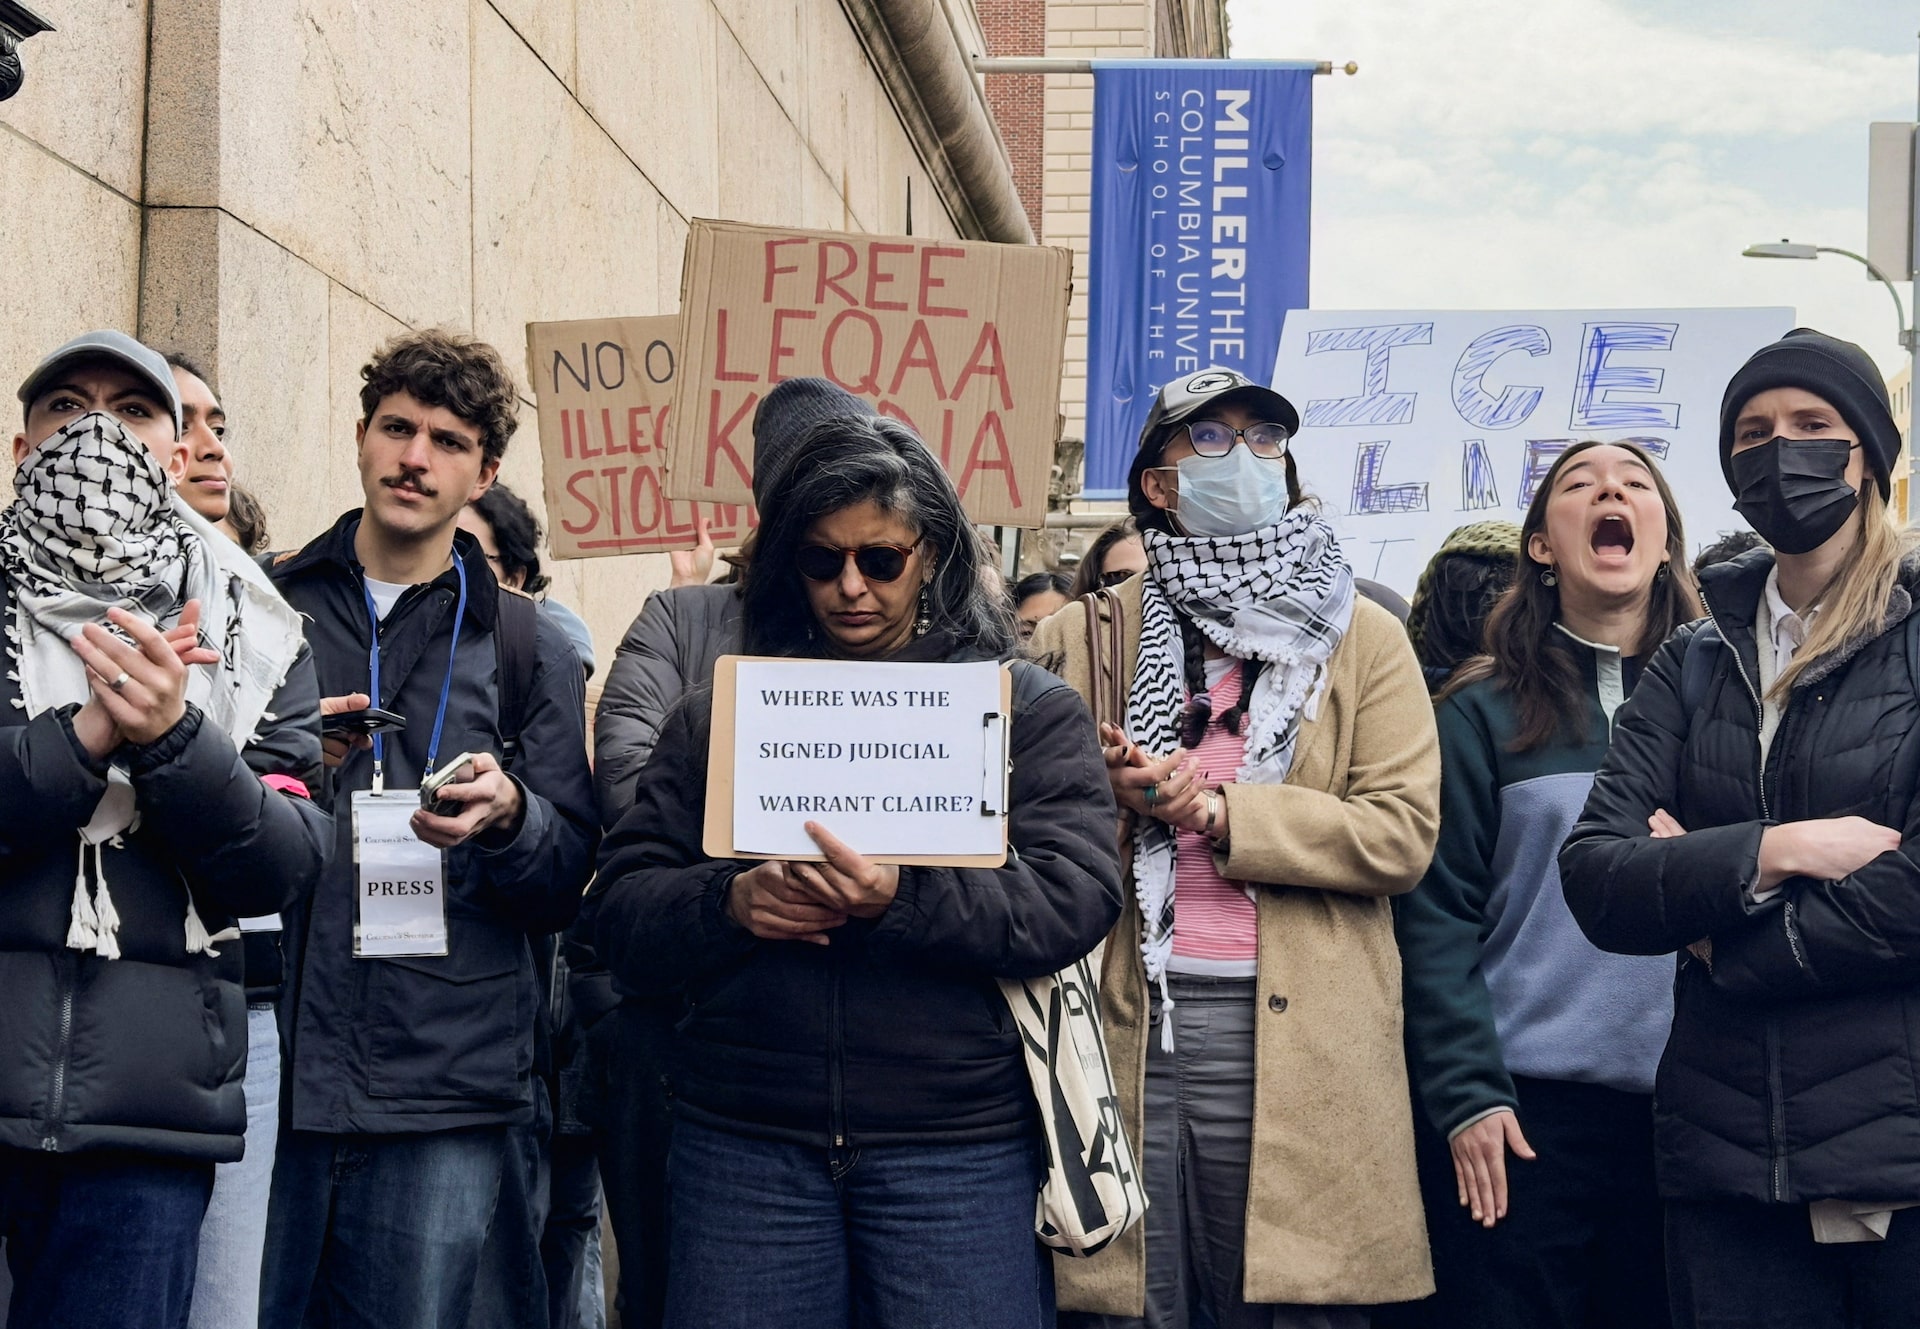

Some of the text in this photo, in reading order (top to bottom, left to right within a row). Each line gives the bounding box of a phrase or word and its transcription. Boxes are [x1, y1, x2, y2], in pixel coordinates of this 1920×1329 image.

[1149, 90, 1170, 359] SCHOOL OF THE
[1175, 89, 1205, 377] COLUMBIA UNIVE
[1210, 89, 1250, 371] MILLERTHE
[763, 238, 968, 318] FREE
[553, 340, 675, 393] NO O
[714, 309, 1014, 410] LEQAA
[1302, 321, 1681, 431] ICE
[1345, 436, 1671, 516] LIE
[761, 690, 950, 707] WHERE WAS THE
[759, 742, 950, 763] SIGNED JUDICIAL
[759, 795, 973, 813] WARRANT CLAIRE?
[367, 881, 434, 896] PRESS
